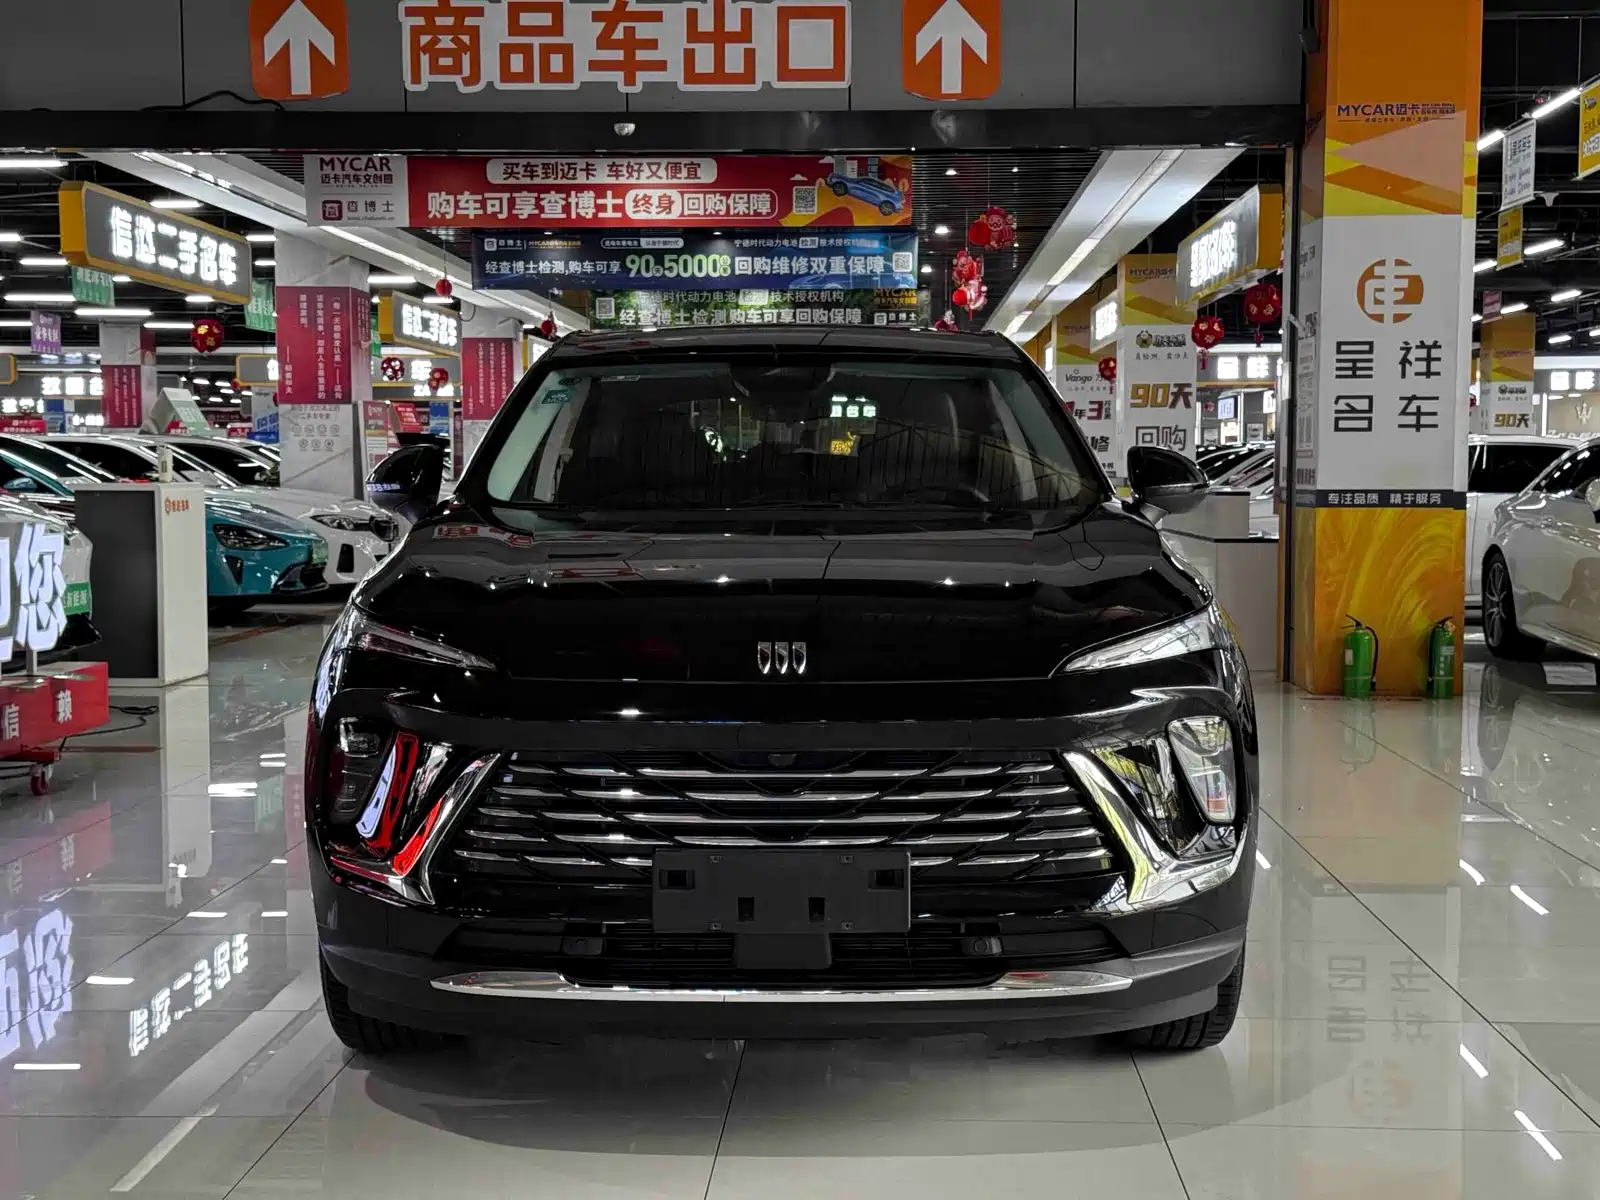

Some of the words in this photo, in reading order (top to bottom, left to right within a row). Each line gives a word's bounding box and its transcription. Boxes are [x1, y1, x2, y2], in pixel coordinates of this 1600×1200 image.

[403, 0, 847, 87] 商品车出口
[319, 157, 392, 171] MYCAR
[502, 161, 598, 182] 买车到迈卡
[607, 161, 702, 181] 车好又便宜
[1335, 340, 1442, 379] 呈祥
[1065, 373, 1093, 384] Vango
[1129, 383, 1193, 409] 90天
[1334, 394, 1440, 432] 名车
[1494, 413, 1530, 428] 90天
[1136, 425, 1187, 451] 回购
[1328, 492, 1379, 505] 专注品质
[1390, 492, 1441, 505] 精于服务
[0, 522, 68, 662] 您
